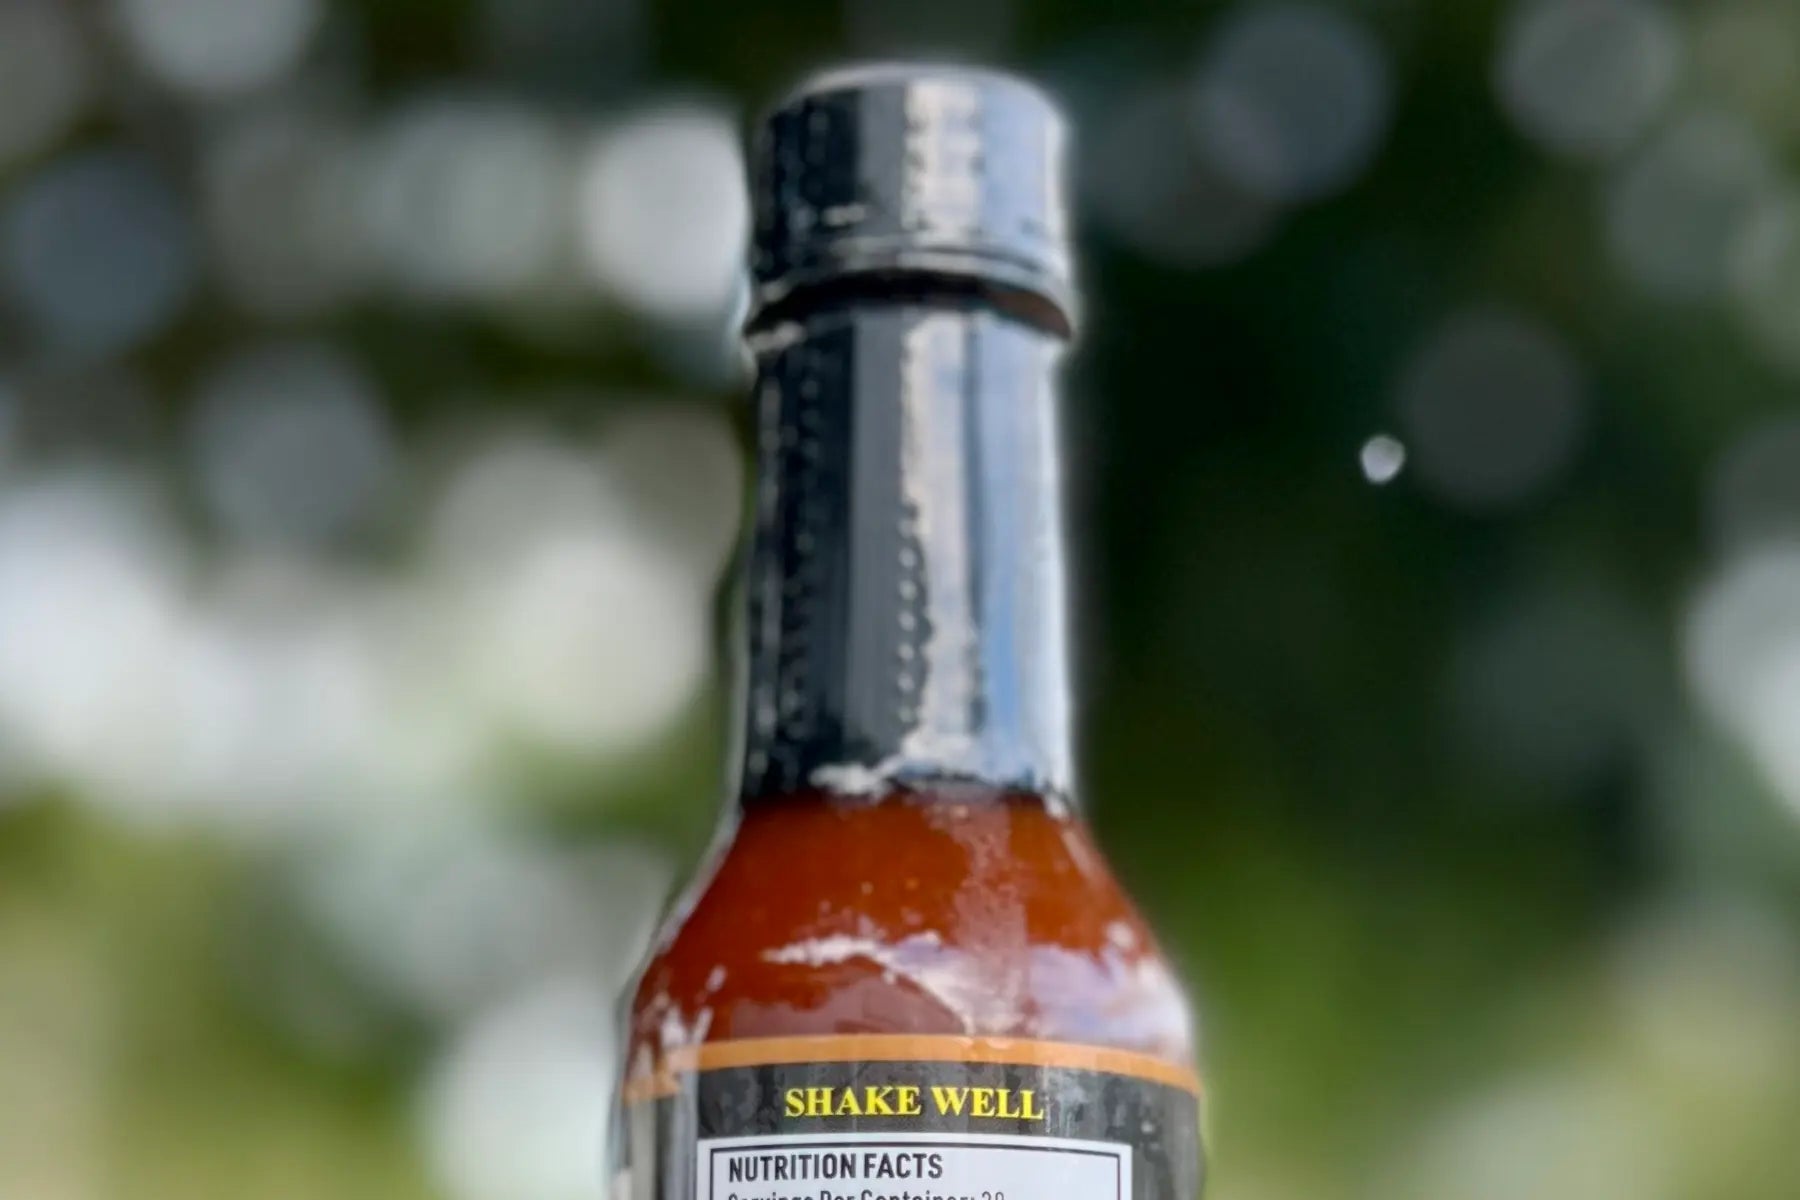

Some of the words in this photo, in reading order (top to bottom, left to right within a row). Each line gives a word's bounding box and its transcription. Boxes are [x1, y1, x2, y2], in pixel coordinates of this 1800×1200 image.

[784, 1087, 921, 1117] SHAKE
[930, 1087, 1044, 1120] WELL
[729, 1154, 857, 1182] NUTRITION
[864, 1154, 943, 1179] FACTS
